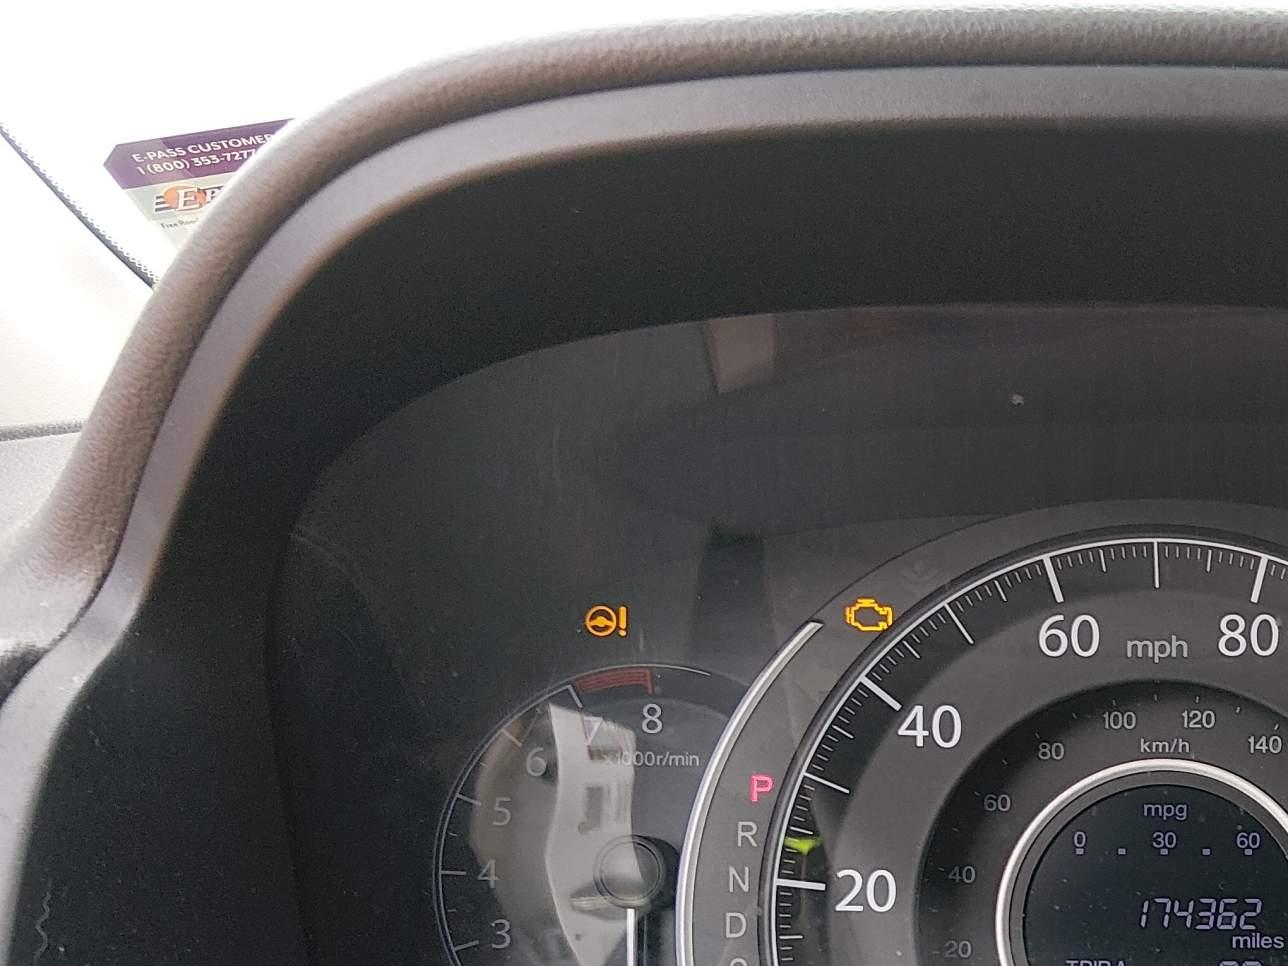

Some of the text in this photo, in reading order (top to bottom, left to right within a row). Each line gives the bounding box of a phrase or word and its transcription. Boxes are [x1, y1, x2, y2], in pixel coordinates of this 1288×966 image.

[147, 160, 190, 175] (800)
[1038, 615, 1100, 657] 60
[1218, 614, 1279, 656] 80
[1126, 636, 1189, 663] mph
[641, 703, 663, 734] 8
[898, 704, 962, 748] 40
[1103, 710, 1137, 730] 100
[1181, 709, 1216, 729] 120
[1038, 743, 1065, 760] 80
[1140, 738, 1191, 754] km/h
[1248, 735, 1283, 754] 140
[525, 748, 547, 777] 6
[751, 774, 774, 802] P
[492, 798, 512, 826] 5
[984, 795, 1012, 812] 60
[1143, 803, 1188, 820] mpg
[737, 821, 758, 847] R
[1073, 832, 1261, 848] 0 30 60
[478, 860, 497, 889] 4
[729, 866, 750, 893] N
[949, 866, 976, 884] 40
[835, 869, 898, 913] 20
[725, 913, 748, 939] D
[1139, 898, 1263, 930] 174362
[491, 919, 512, 949] 3
[1232, 932, 1285, 949] miles
[944, 940, 973, 959] 20
